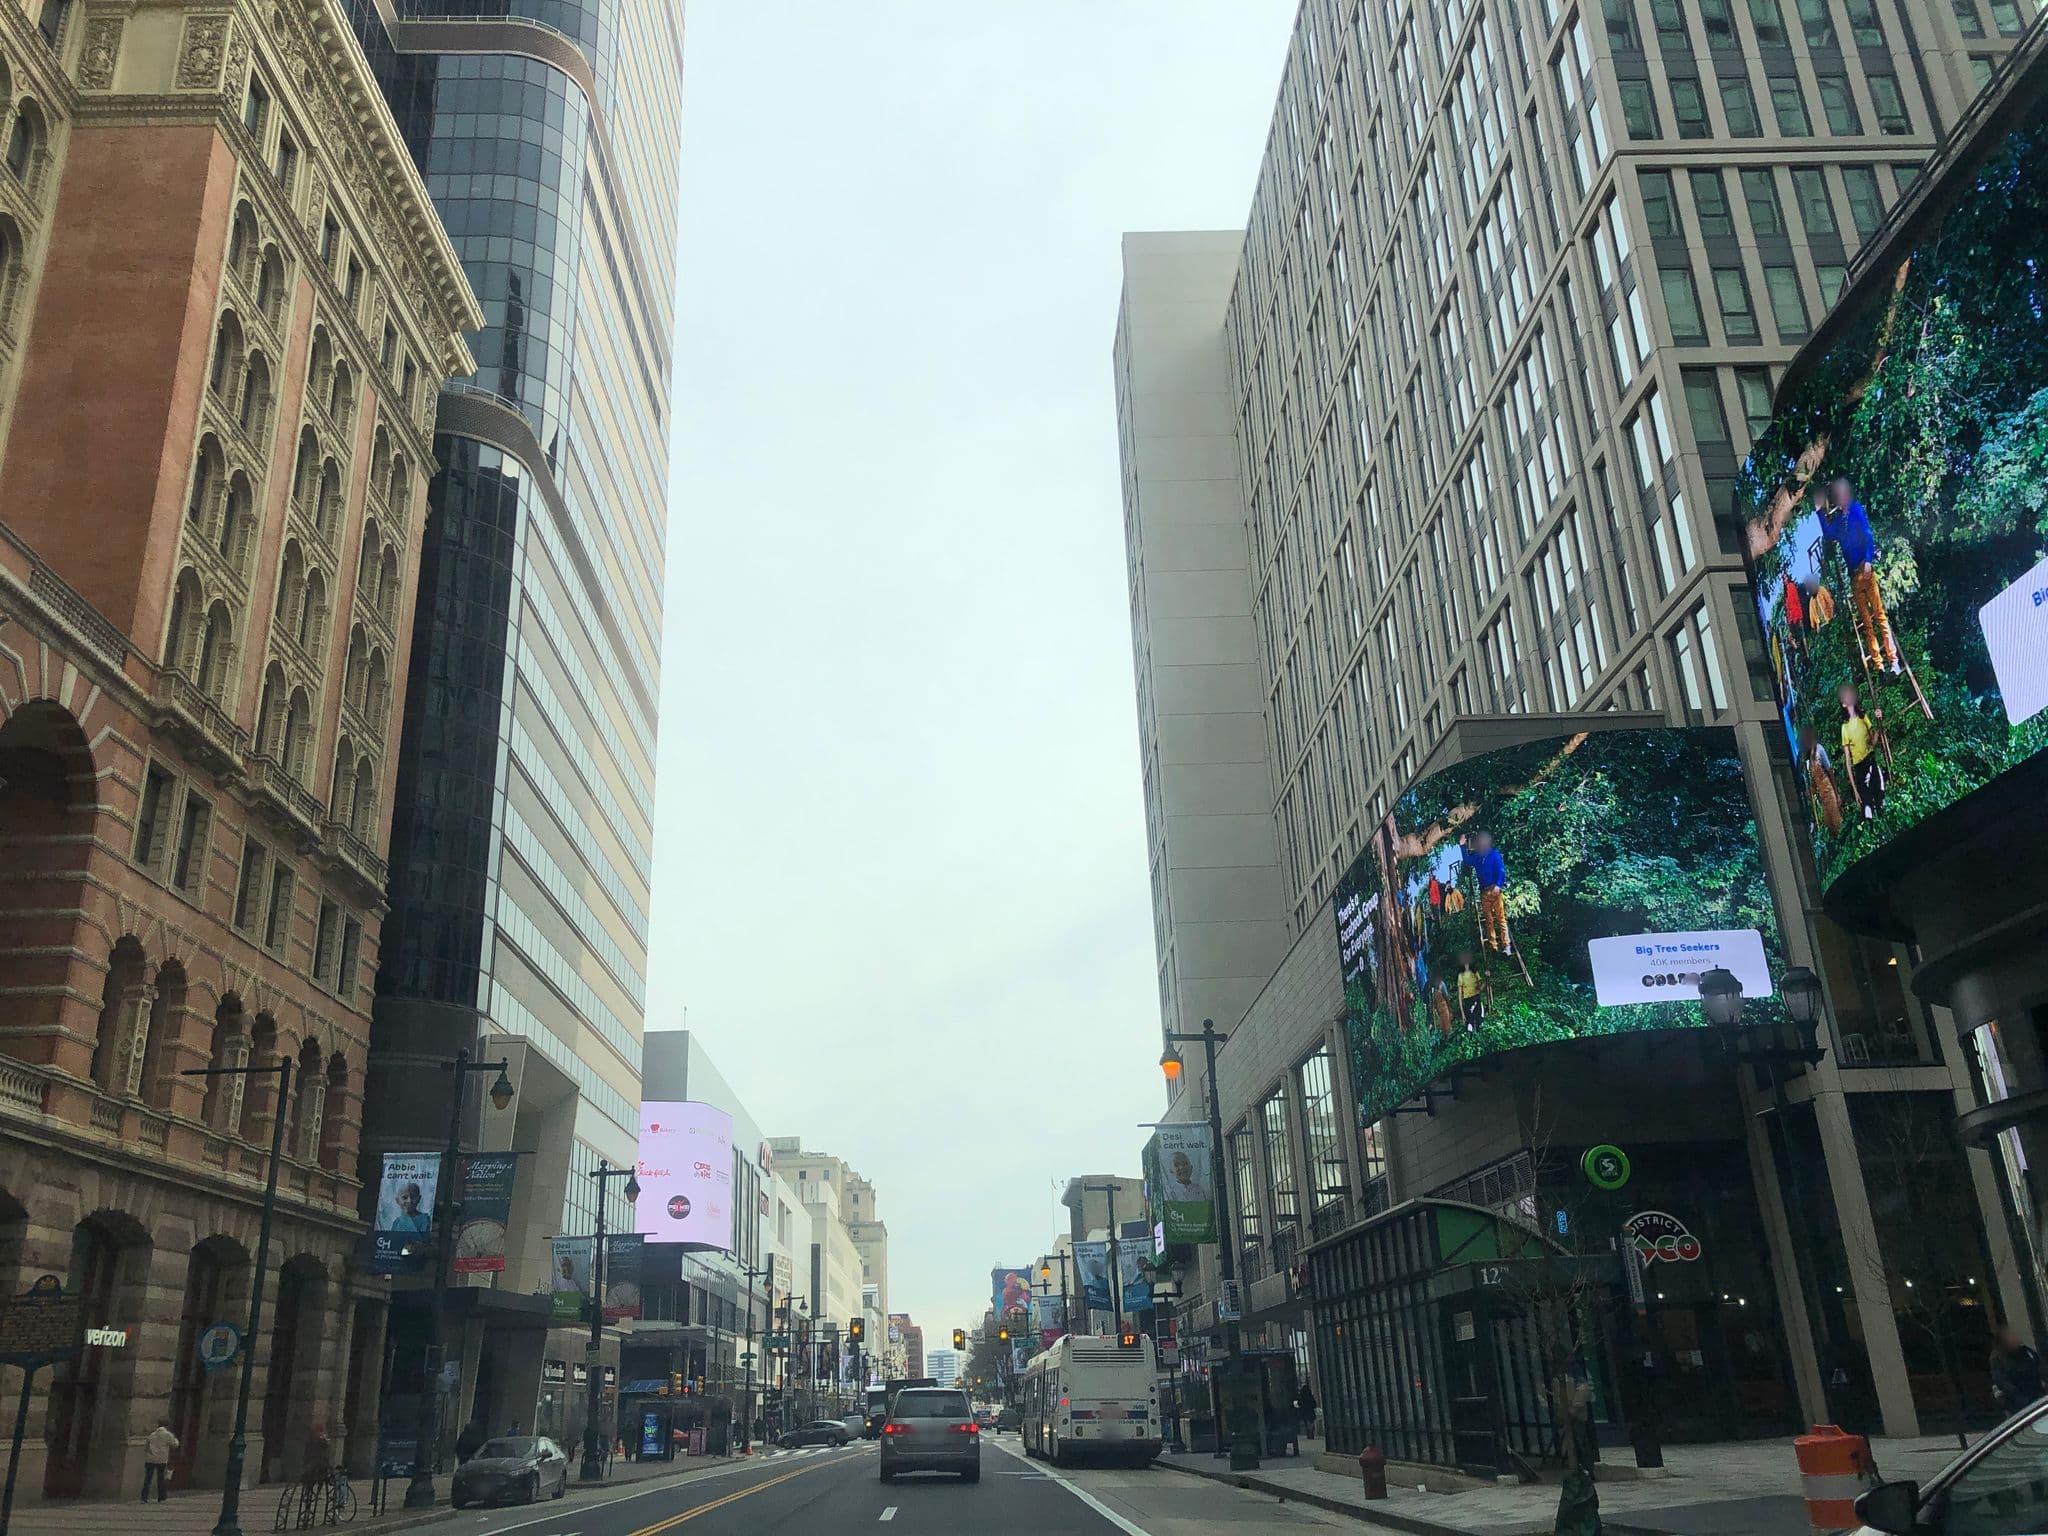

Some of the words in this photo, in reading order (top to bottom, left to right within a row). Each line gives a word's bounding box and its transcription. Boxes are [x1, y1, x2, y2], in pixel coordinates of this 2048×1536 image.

[1341, 907, 1364, 946] Facebook
[1362, 892, 1379, 918] Group
[1343, 948, 1351, 966] For
[1350, 922, 1374, 956] Everyone
[1635, 945, 1653, 956] Big
[1654, 944, 1678, 954] Tree
[1679, 942, 1720, 952] Seekers
[1650, 958, 1668, 967] 40K
[1669, 957, 1712, 966] members
[1163, 1133, 1181, 1141] Desi
[1163, 1142, 1185, 1150] can't
[388, 1163, 416, 1172] Abbie
[387, 1172, 410, 1180] can't
[1633, 1234, 1701, 1268] ACO
[86, 1325, 126, 1347] verizon
[1123, 1335, 1134, 1345] 17
